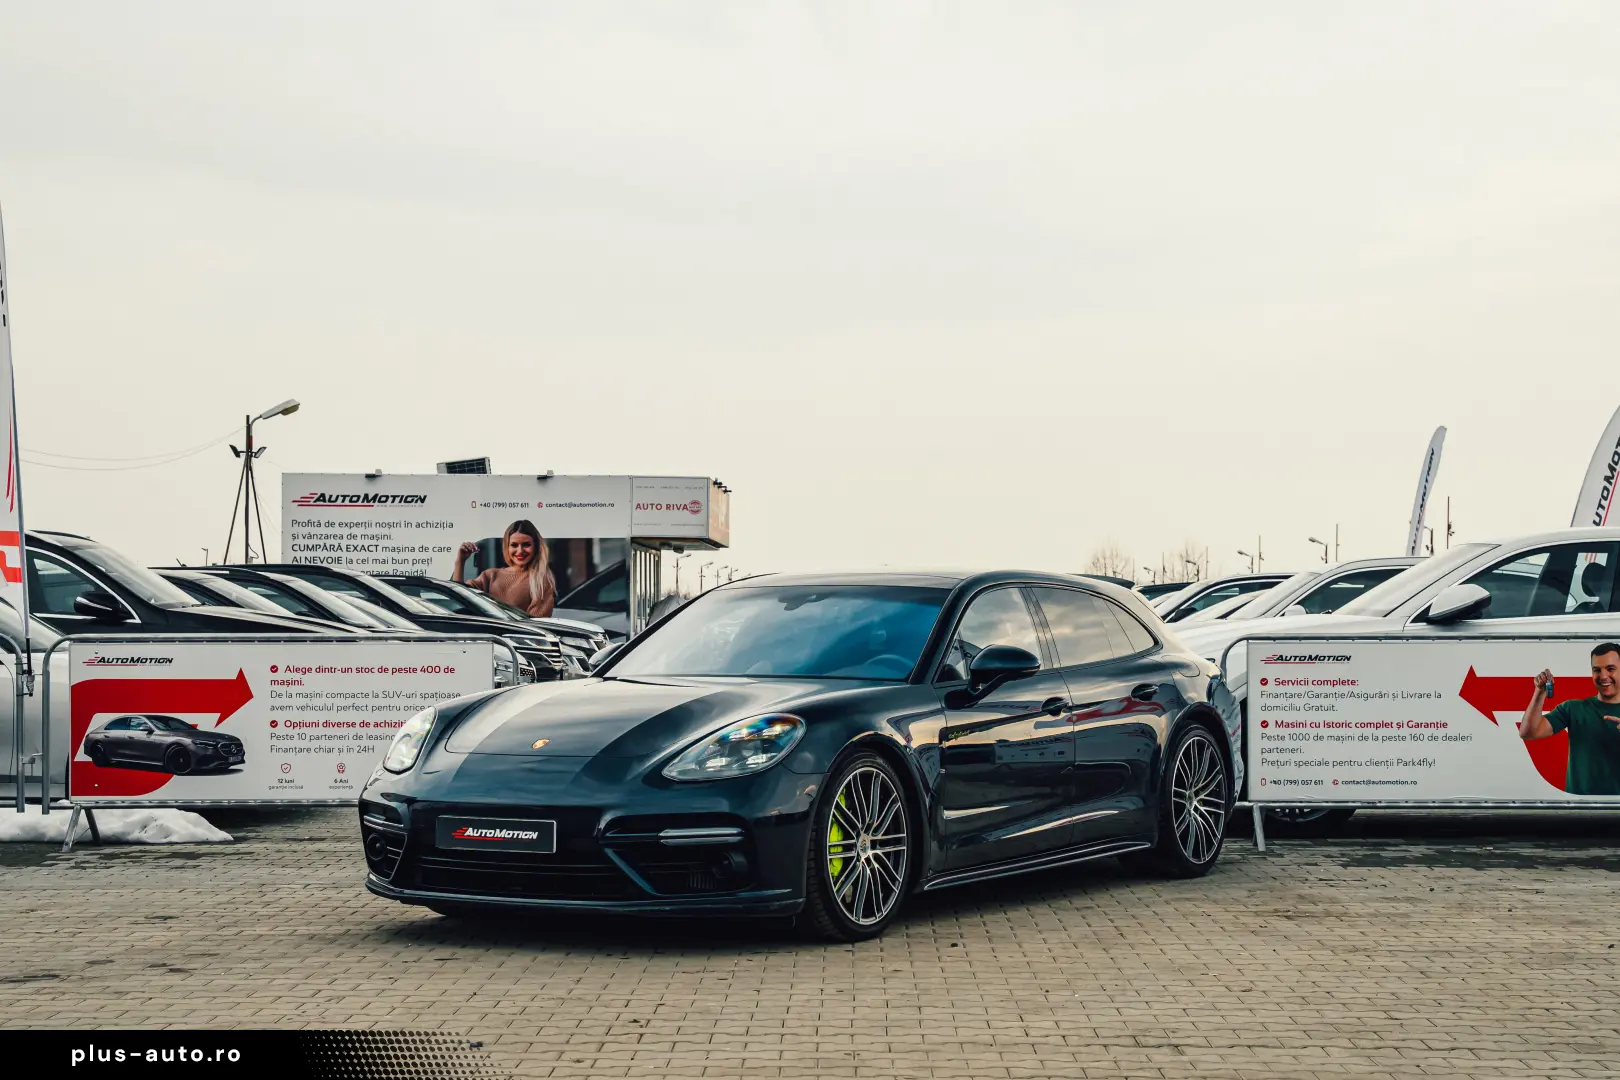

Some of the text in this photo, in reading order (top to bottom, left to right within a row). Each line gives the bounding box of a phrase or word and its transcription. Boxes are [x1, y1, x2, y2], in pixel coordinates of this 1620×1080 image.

[313, 493, 427, 503] AUTOMOTION
[666, 503, 688, 511] RIVA
[324, 520, 335, 528] de
[404, 520, 412, 528] în
[301, 532, 343, 540] vânzarea
[346, 544, 379, 552] EXACT
[292, 556, 302, 565] AI
[304, 556, 342, 565] NEVOIE
[346, 557, 353, 565] la
[97, 656, 173, 664] AUTOMOTION
[1274, 654, 1352, 662] AUTOMOTION
[284, 665, 312, 675] Alege
[315, 665, 352, 673] dintr-un
[377, 665, 389, 673] de
[392, 667, 418, 675] peste
[420, 665, 441, 673] 400
[1274, 678, 1358, 688] Servicii complete:
[271, 690, 283, 698] De
[286, 690, 292, 698] la
[326, 692, 369, 700] compacte
[382, 690, 417, 698] SUV-uri
[1401, 691, 1431, 699] Livrare
[296, 703, 334, 711] vehiculul
[337, 703, 368, 713] perfect
[372, 704, 400, 713] pentru
[403, 704, 425, 712] orice
[1261, 703, 1338, 711] domiciliu Gratuit.
[322, 720, 356, 728] diverse
[359, 720, 371, 728] de
[373, 720, 407, 728] achizi
[1323, 720, 1352, 728] Istoric
[1355, 720, 1394, 730] complet
[309, 733, 349, 742] parteneri
[1261, 733, 1285, 741] Peste
[1288, 733, 1310, 741] 1000
[1313, 733, 1324, 741] de
[1358, 733, 1369, 741] de
[1372, 733, 1379, 741] la
[1382, 735, 1406, 743] peste
[1409, 733, 1424, 741] 160
[1427, 733, 1439, 741] de
[1441, 733, 1472, 741] dealeri
[314, 745, 335, 753] chiar
[346, 745, 354, 753] în
[357, 745, 374, 753] 24H
[1261, 746, 1304, 755] parteneri.
[1294, 758, 1329, 768] speciale
[1332, 760, 1362, 768] pentru
[1397, 758, 1435, 768] Park4fly!
[464, 827, 538, 839] AUTOMOTION
